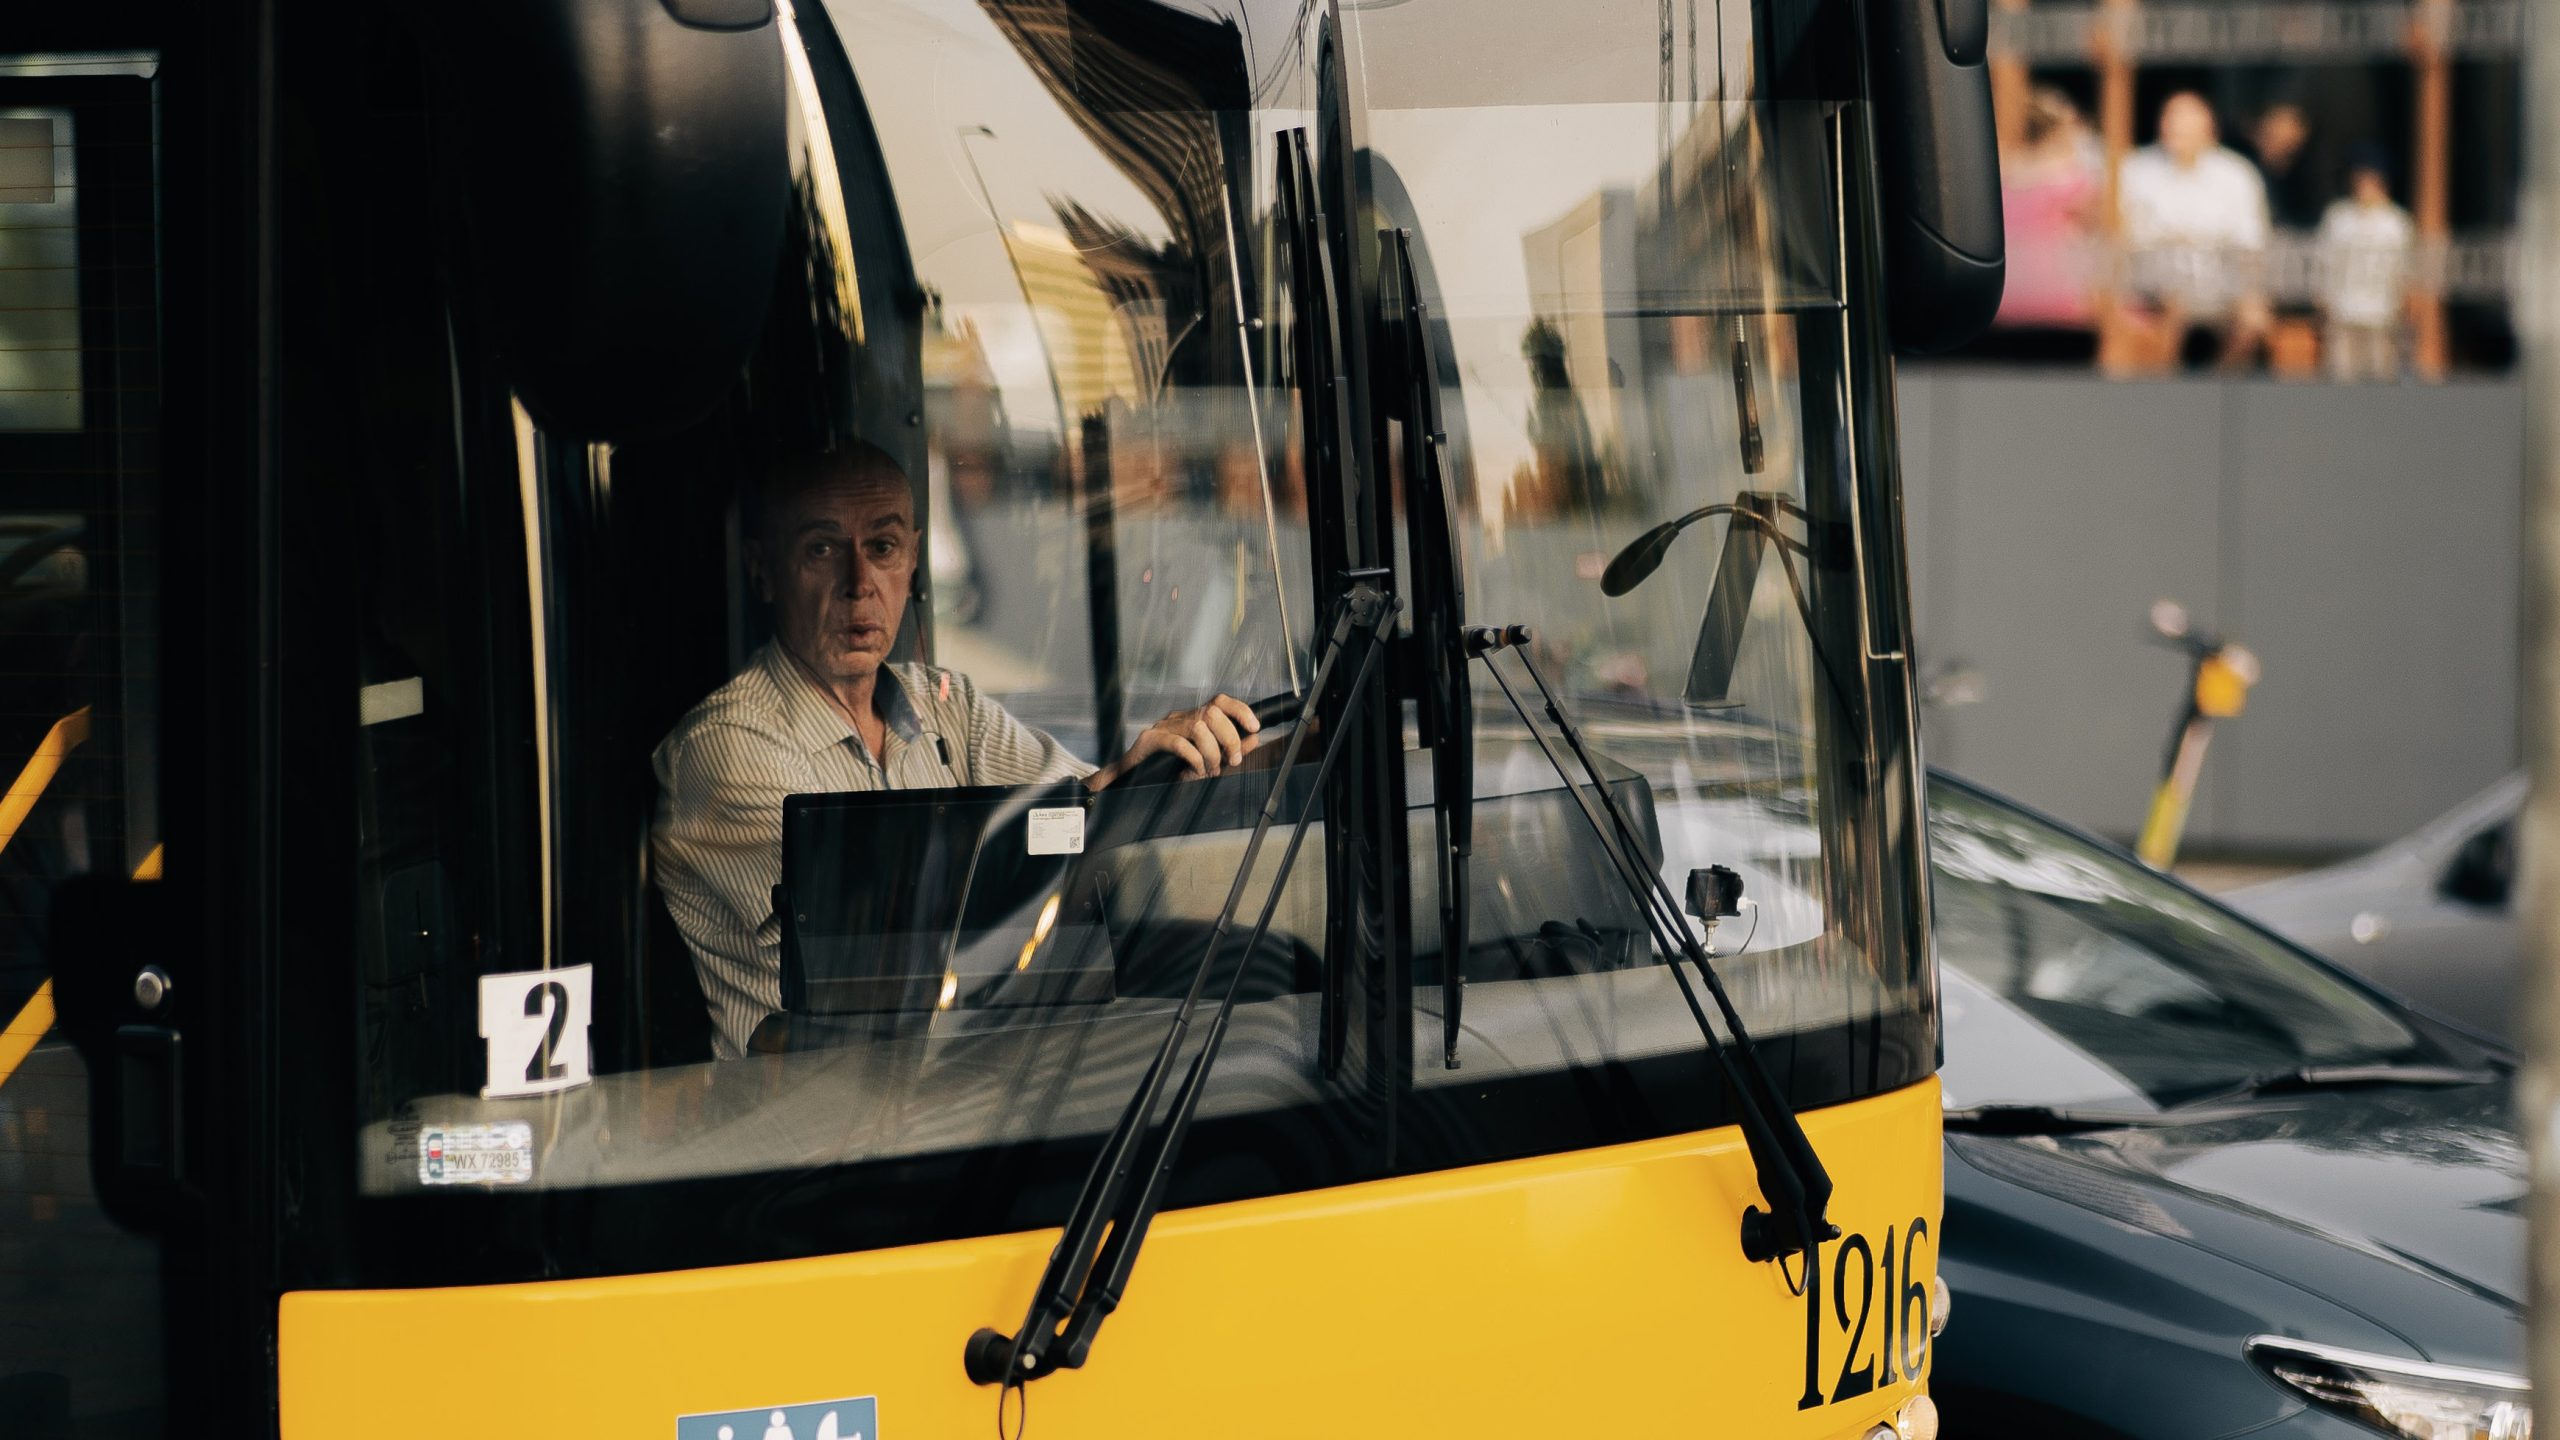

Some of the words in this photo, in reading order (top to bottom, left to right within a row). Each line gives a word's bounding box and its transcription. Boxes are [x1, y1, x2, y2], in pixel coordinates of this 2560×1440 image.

[524, 981, 568, 1081] 2
[453, 1154, 477, 1169] WX
[1798, 1216, 1928, 1411] 1216
